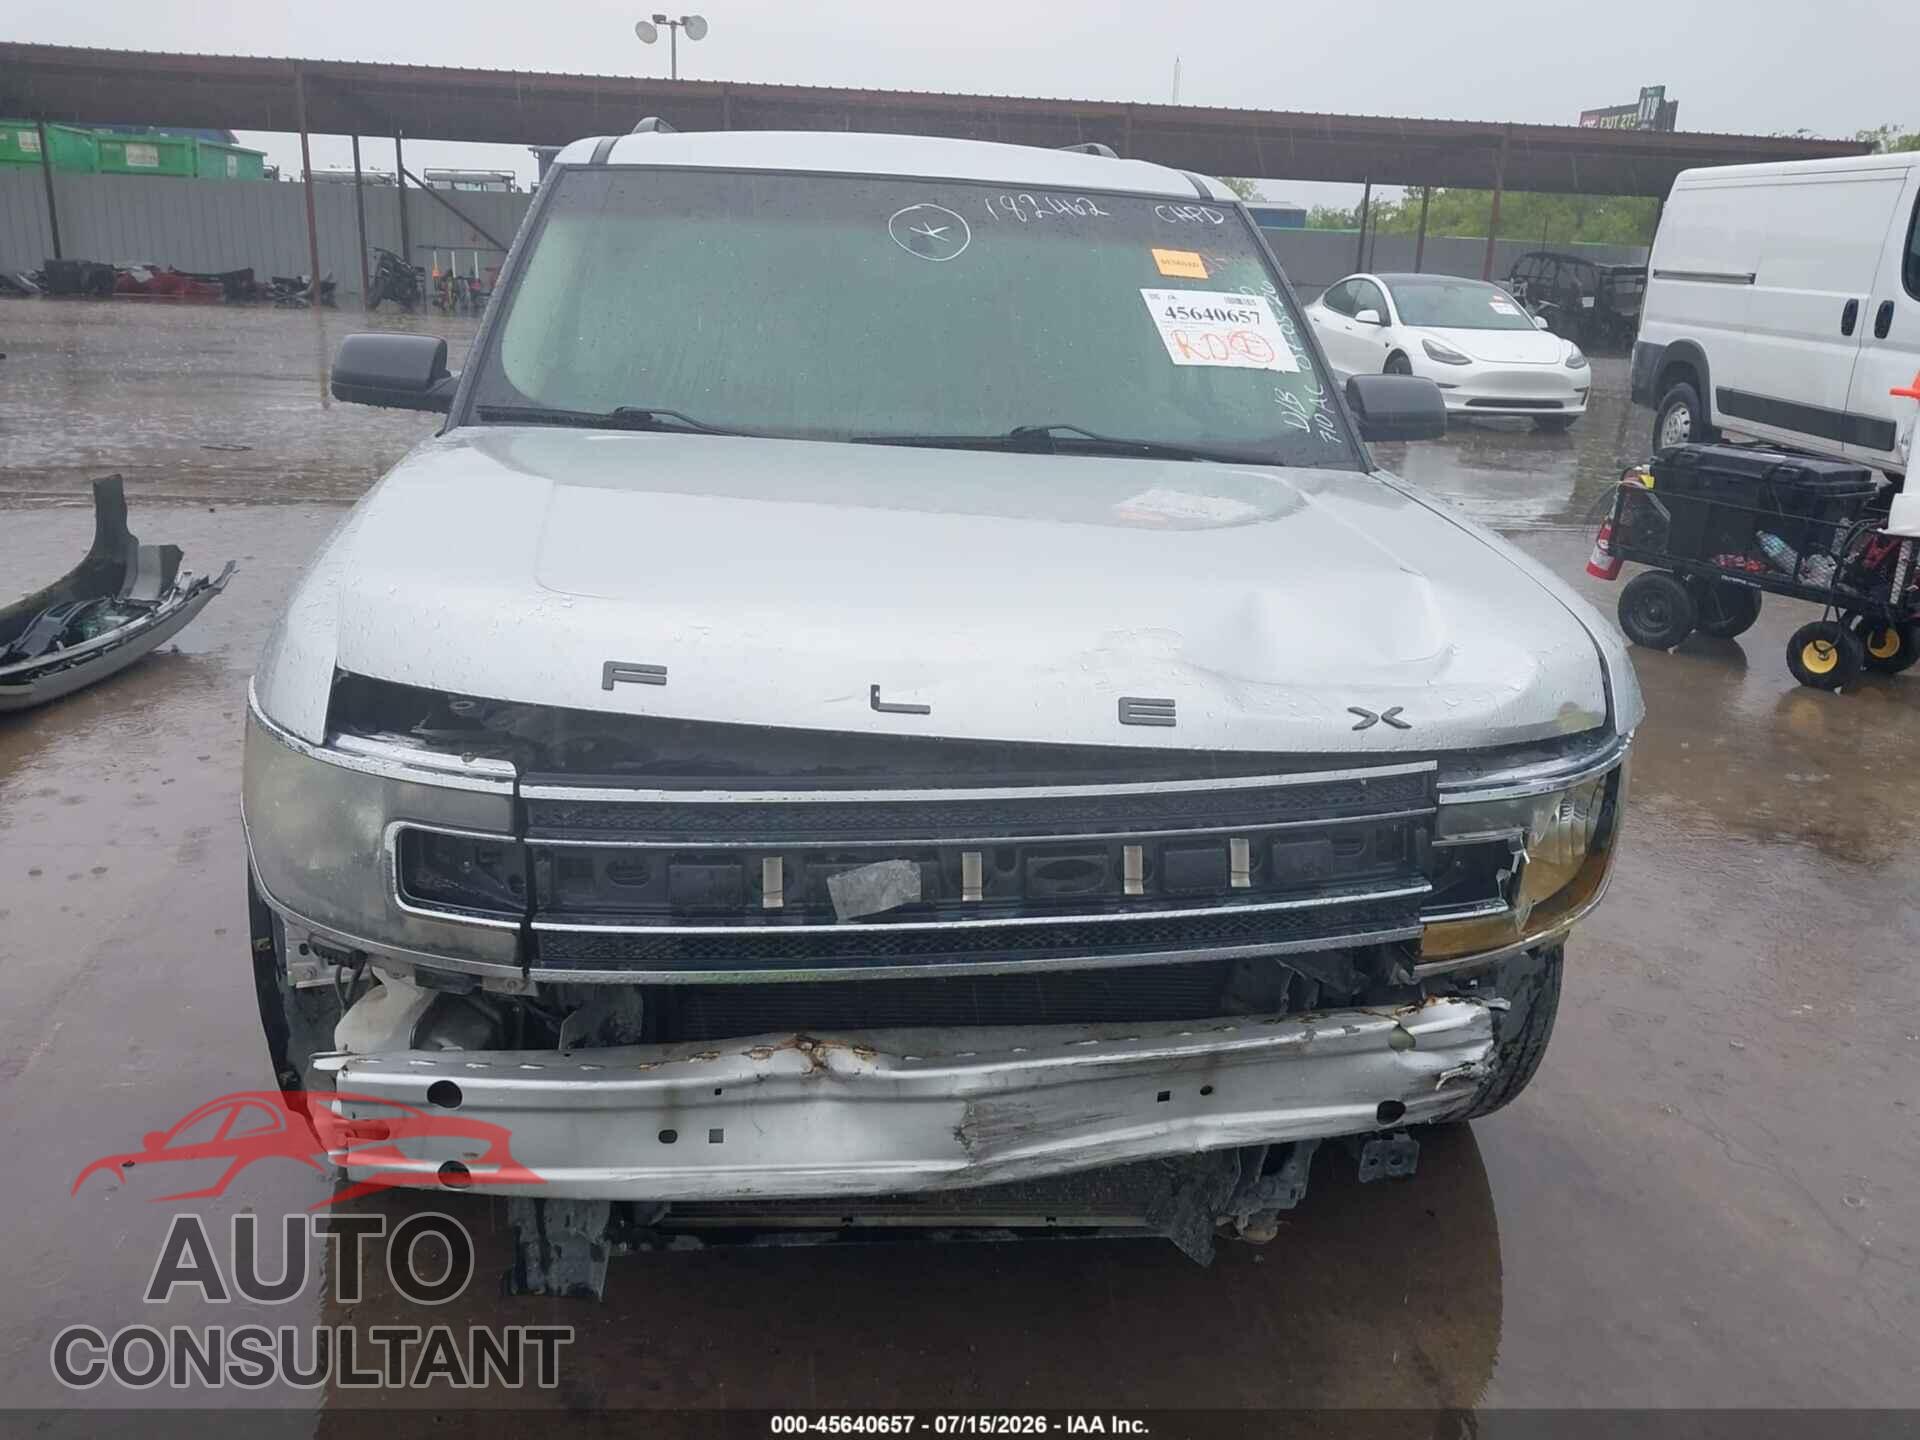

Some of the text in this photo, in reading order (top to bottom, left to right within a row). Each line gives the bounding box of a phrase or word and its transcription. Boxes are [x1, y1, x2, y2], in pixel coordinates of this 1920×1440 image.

[1600, 115, 1620, 129] EXIT
[1164, 306, 1260, 325] 45640657
[602, 660, 1413, 732] FLEX
